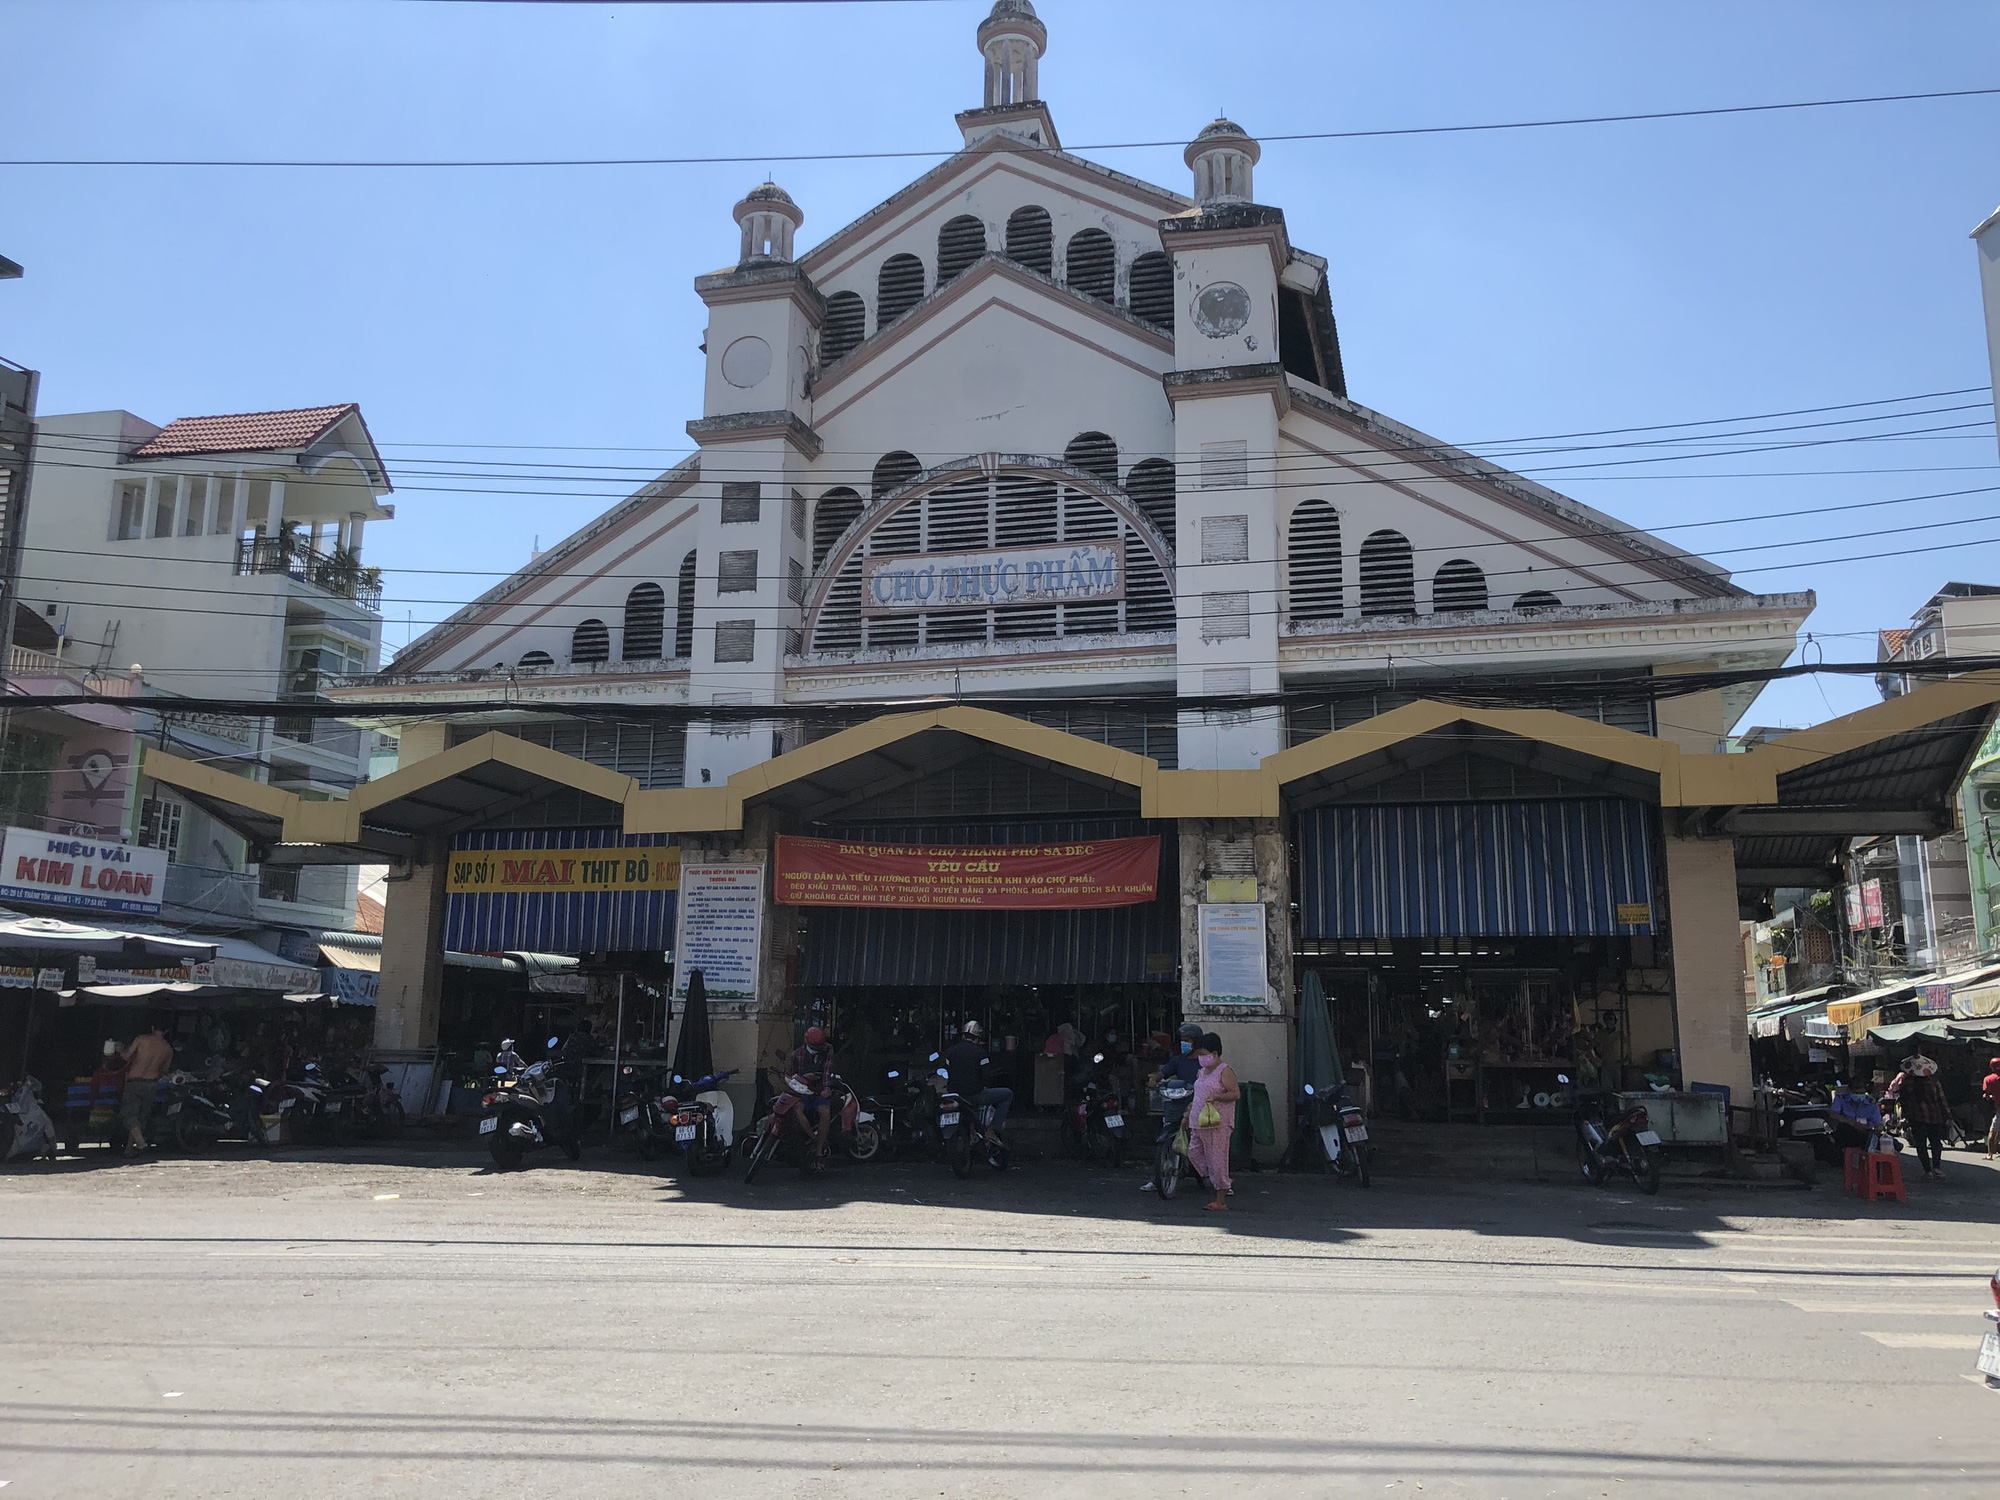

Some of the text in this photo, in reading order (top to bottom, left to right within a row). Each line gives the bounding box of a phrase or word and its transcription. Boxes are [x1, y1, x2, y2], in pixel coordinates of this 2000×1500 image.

[873, 547, 1114, 606] CHỢ THỰC PHẨM
[47, 840, 96, 857] HIỆU
[839, 845, 864, 854] BAN
[1044, 847, 1062, 856] SA
[454, 862, 472, 889] SẠP
[475, 855, 489, 883] SỐ
[490, 863, 495, 884] 1
[501, 859, 576, 886] MAI
[581, 860, 620, 889] THỊT
[625, 854, 649, 883] BÒ
[927, 859, 1001, 872] YÊU CẦU
[16, 856, 154, 896] KIM LOAN
[814, 872, 834, 880] DÂN
[836, 871, 847, 881] VÀ
[912, 874, 938, 884] THỰC
[940, 875, 963, 884] HIỆN
[1005, 876, 1022, 884] KHI
[1024, 875, 1044, 884] VÀO
[1046, 875, 1067, 885] CHỢ
[862, 894, 876, 902] KHI
